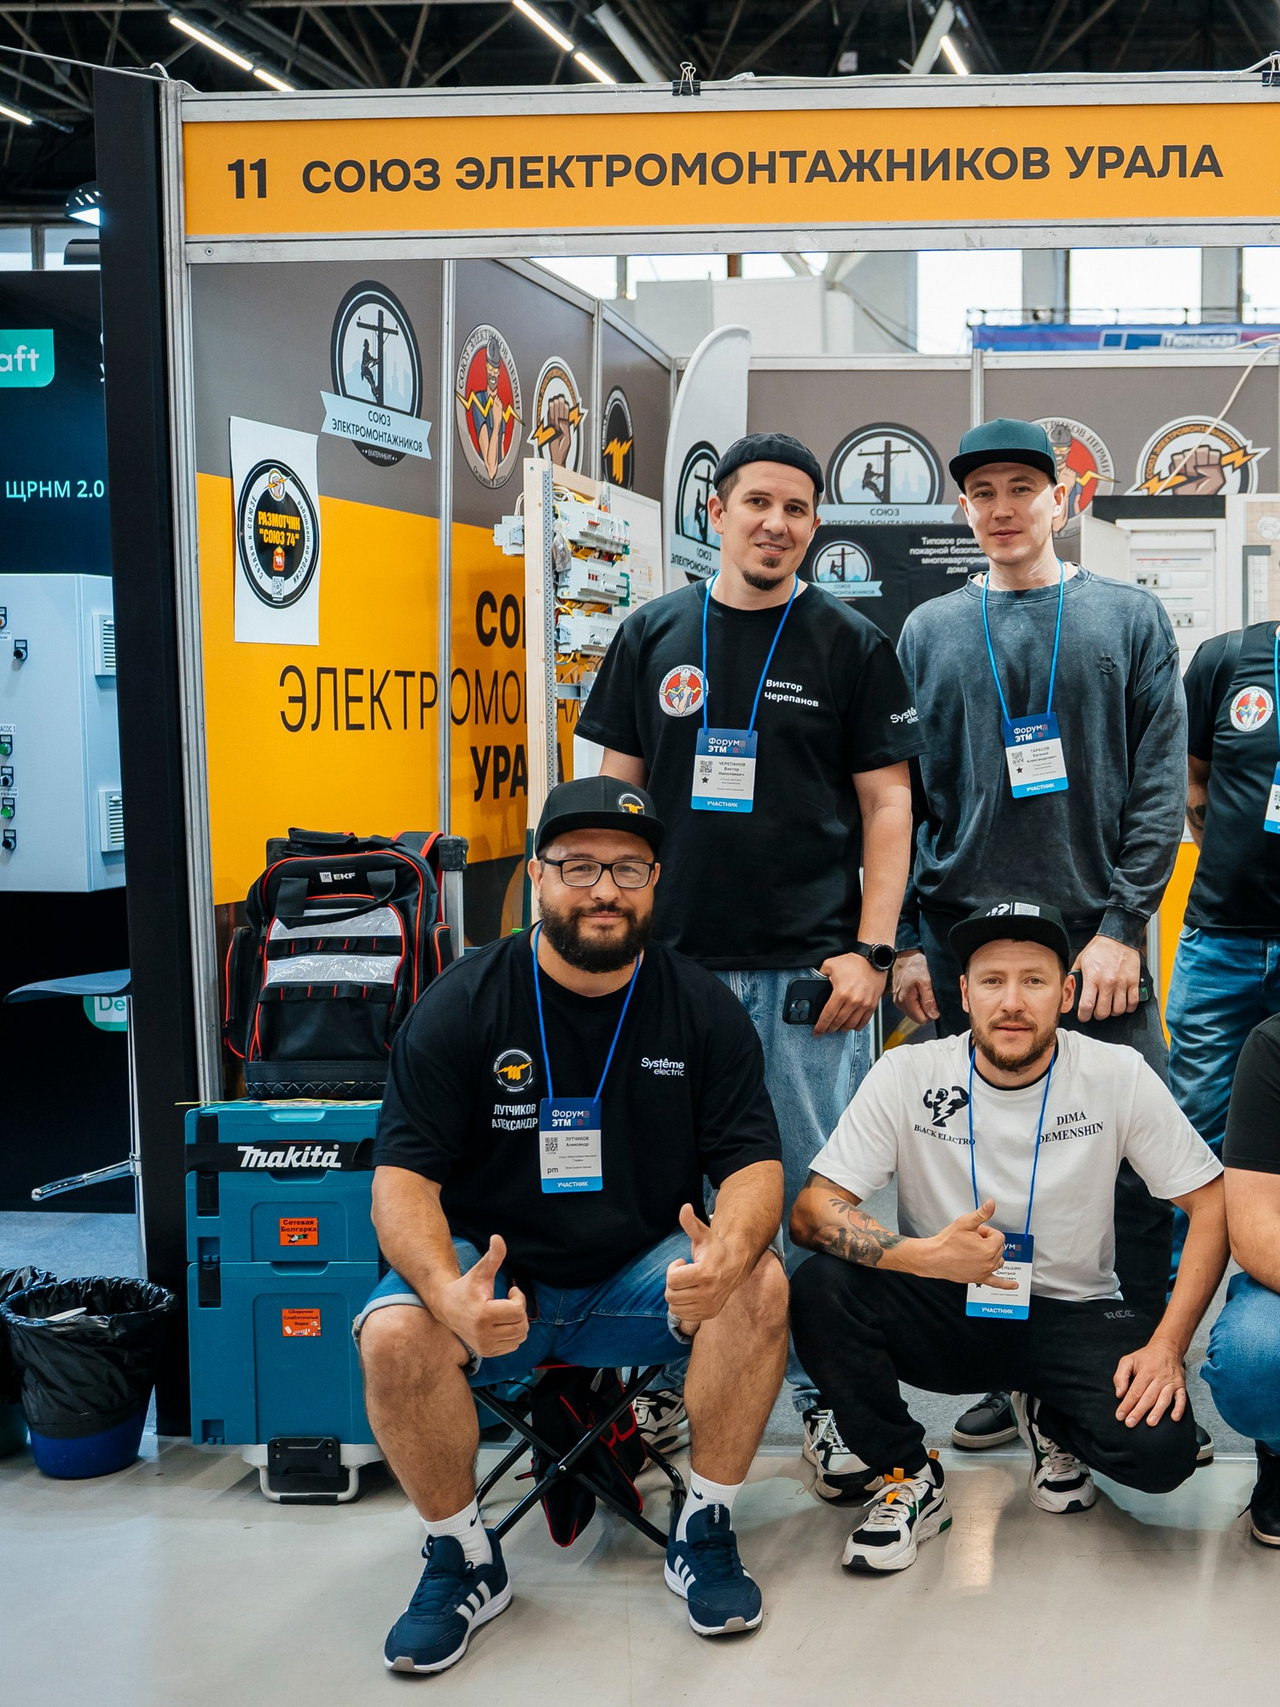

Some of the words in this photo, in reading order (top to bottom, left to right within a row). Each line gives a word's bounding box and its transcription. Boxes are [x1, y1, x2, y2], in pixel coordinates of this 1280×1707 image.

[228, 158, 268, 199] 11
[302, 158, 441, 194] СОЮЗ
[456, 147, 1049, 190] ЭЛЕКТРОМОНТАЖНИКОВ
[1068, 144, 1224, 180] УРАЛА
[0, 345, 40, 372] aft
[368, 410, 391, 426] СОЮЗ
[332, 419, 423, 452] ЭЛЕКТРОМОНТАЖНИКОВ
[6, 480, 70, 502] ЩРНМ
[76, 480, 105, 498] 2.0
[870, 508, 900, 516] СОЮЗ
[258, 511, 300, 530] РАЗМОТЧИК
[921, 537, 955, 545] Типовое
[909, 547, 949, 556] пожарной
[946, 566, 968, 575] дома
[476, 591, 526, 649] СО
[766, 679, 803, 692] Виктор
[764, 691, 819, 707] Черепанов
[890, 707, 917, 723] Systê
[1014, 725, 1043, 734] Форум
[708, 737, 740, 747] Форум
[1015, 733, 1033, 742] ЭТМ
[708, 745, 727, 753] ЭТМ
[1026, 783, 1055, 792] УЧАСТНИК
[333, 872, 356, 881] EKF
[653, 1068, 684, 1077] electric
[493, 1104, 537, 1117] ЛУТЧИКОВ
[552, 1110, 584, 1119] Форум
[491, 1118, 538, 1131] АЛЕКСАНДР
[552, 1119, 571, 1127] ЭТМ
[1056, 1110, 1087, 1126] DIMA
[1038, 1122, 1104, 1144] DEMENSHIN
